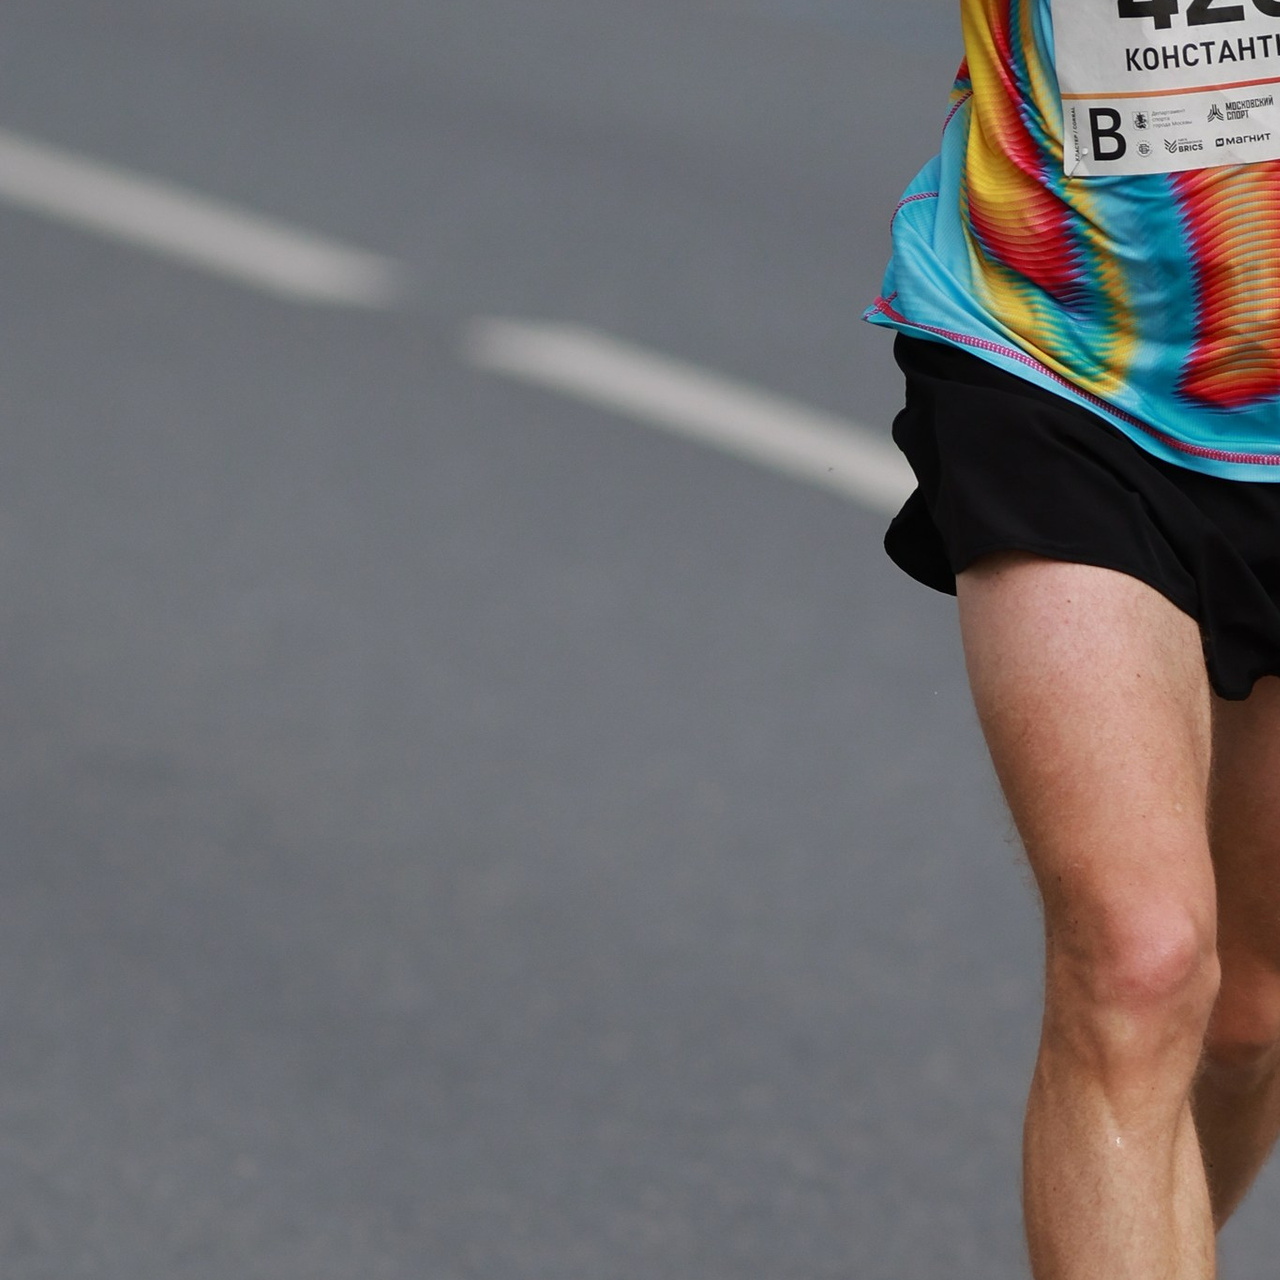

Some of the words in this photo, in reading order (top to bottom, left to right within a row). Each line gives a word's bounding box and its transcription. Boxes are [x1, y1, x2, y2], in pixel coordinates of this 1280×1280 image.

[1225, 94, 1273, 111] МОСКОВСКИЙ
[1226, 109, 1249, 121] СПОРТ
[1178, 143, 1203, 153] BRICS
